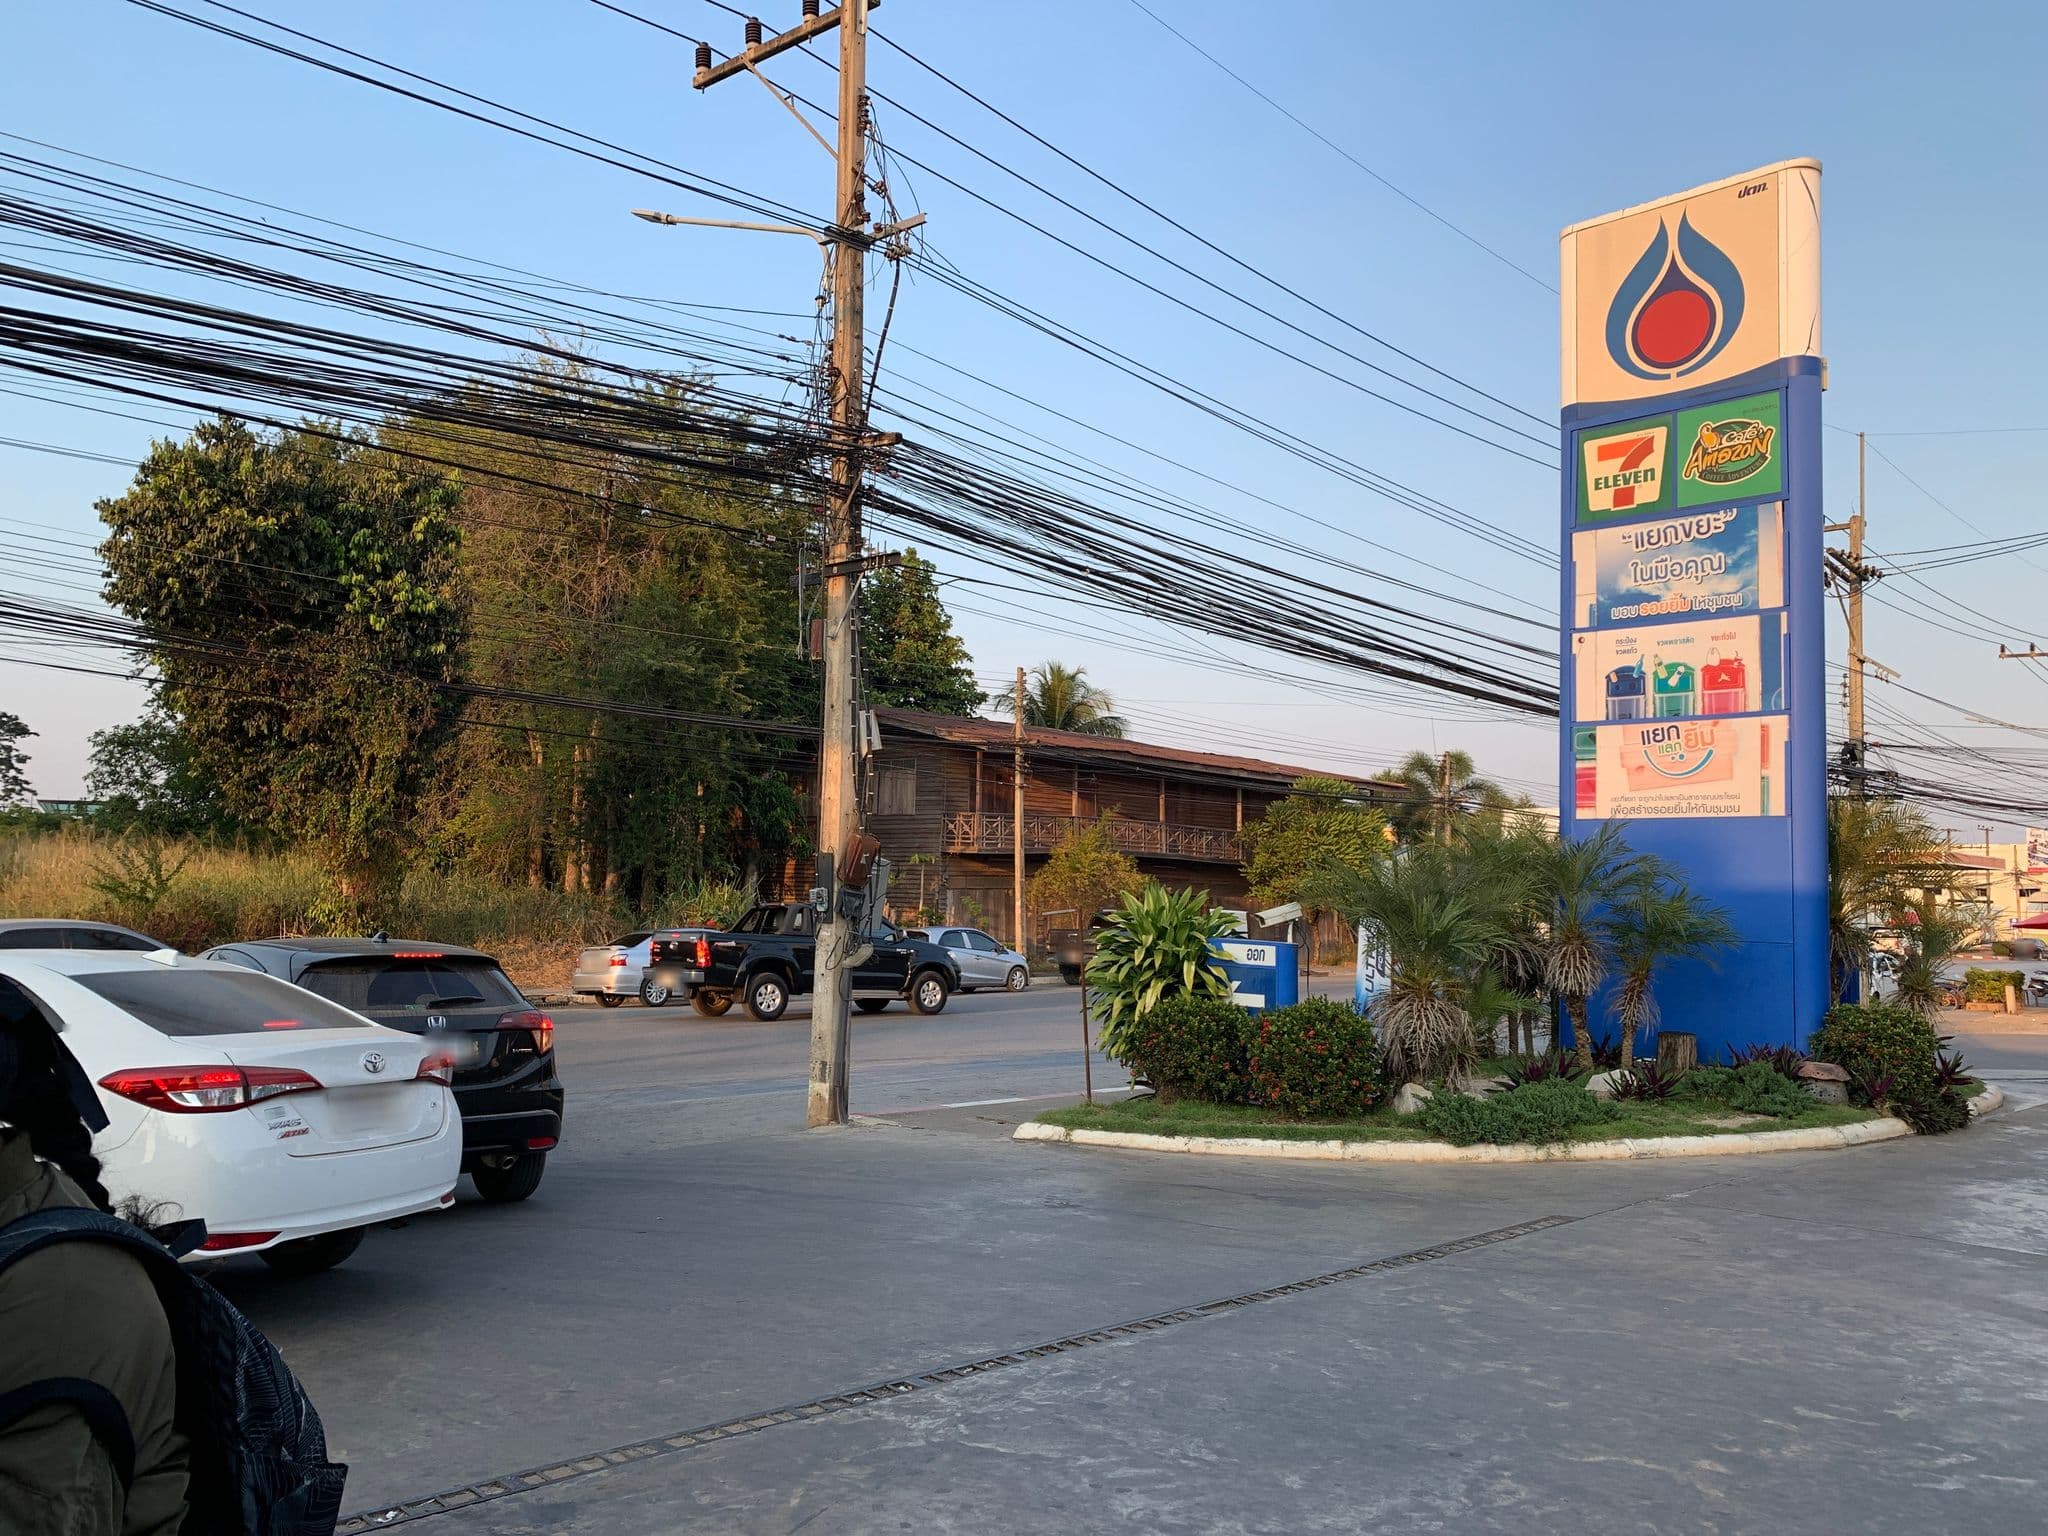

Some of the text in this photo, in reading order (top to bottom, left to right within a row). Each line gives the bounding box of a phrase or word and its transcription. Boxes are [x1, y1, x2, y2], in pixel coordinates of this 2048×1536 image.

[1598, 435, 1655, 508] 7
[1630, 553, 1726, 585] ในมือคุณ
[1641, 725, 1681, 746] แยก
[1658, 742, 1682, 755] แลก
[1246, 948, 1266, 961] ออก
